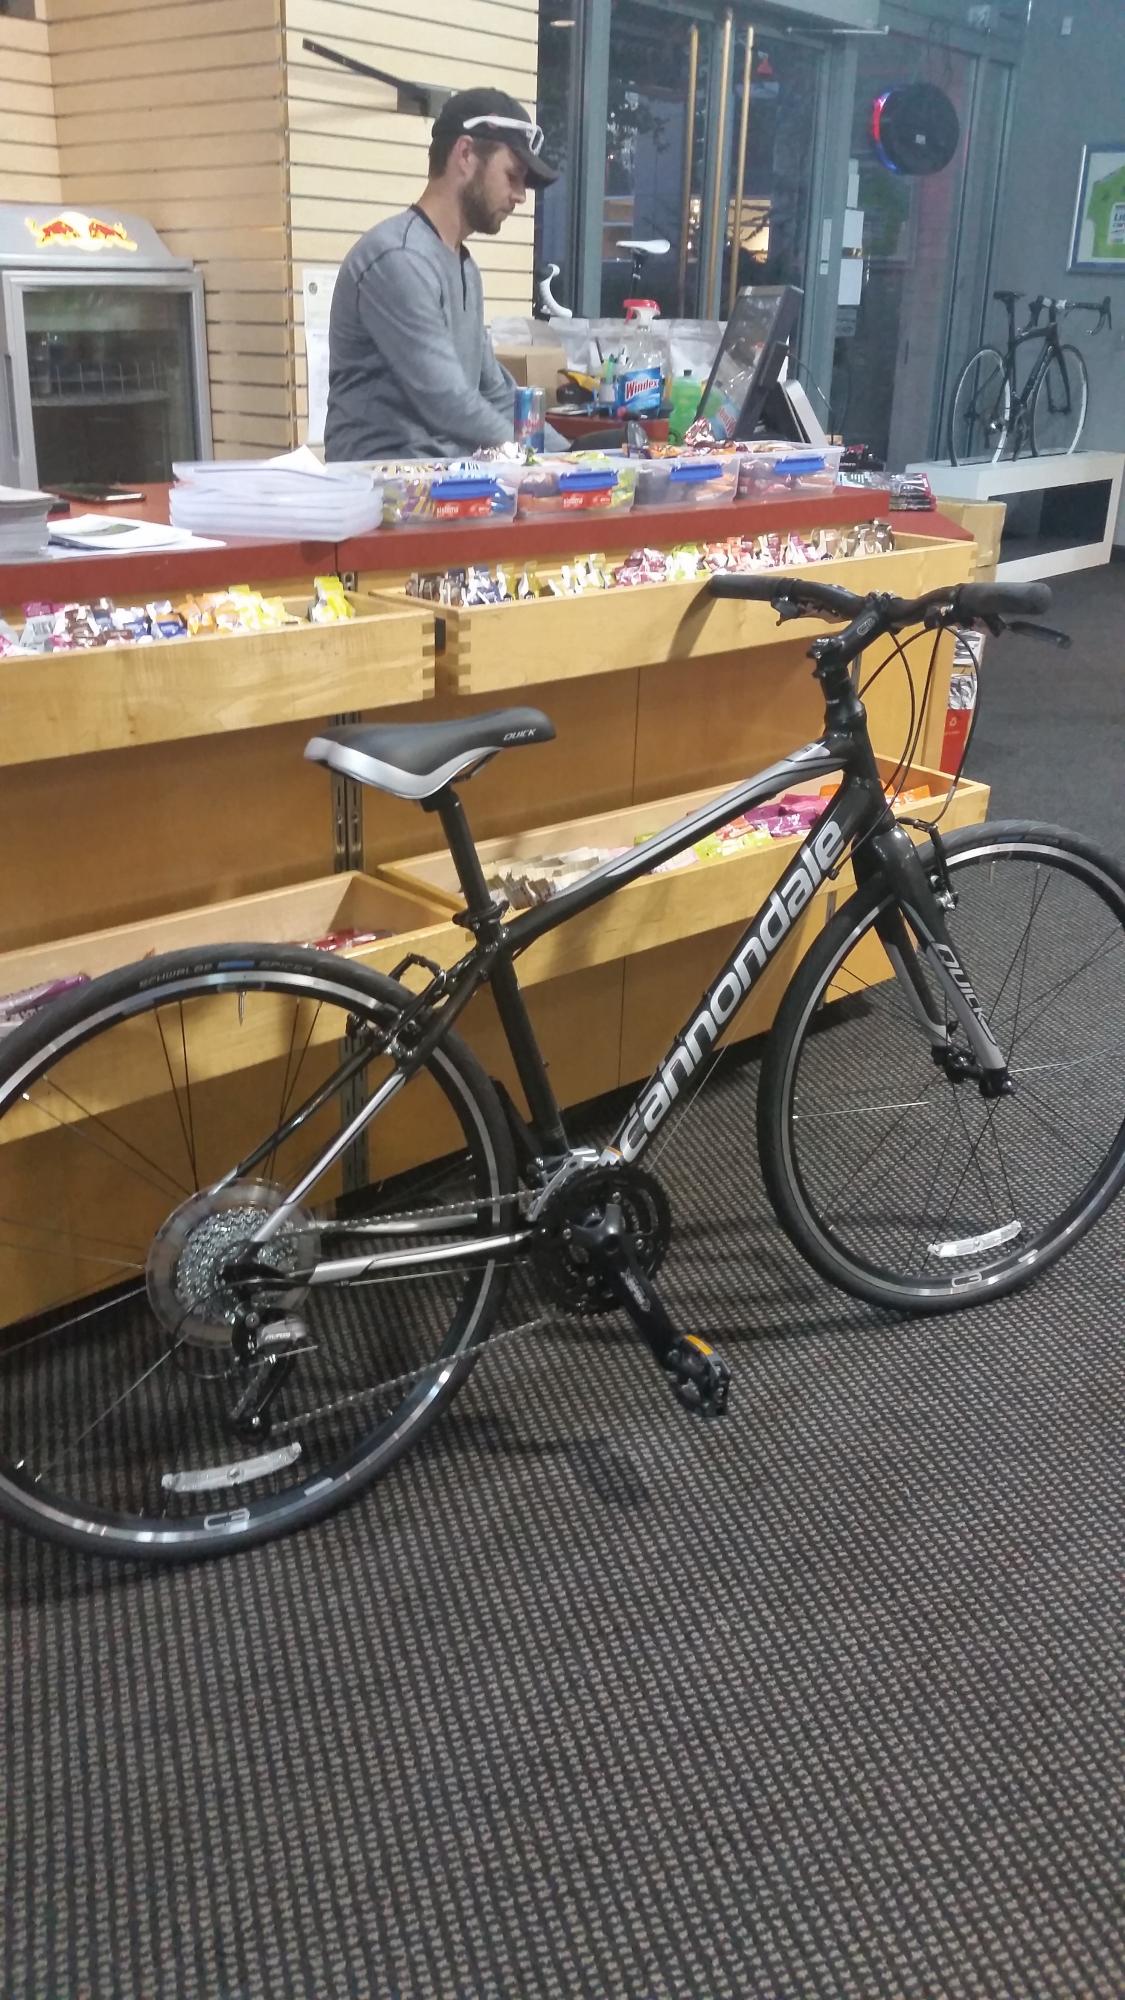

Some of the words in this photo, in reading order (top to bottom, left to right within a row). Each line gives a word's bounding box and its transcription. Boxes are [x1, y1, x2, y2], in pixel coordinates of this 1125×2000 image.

[625, 377, 660, 400] Windex
[503, 728, 537, 741] QUICK
[619, 820, 845, 1163] cannondale
[933, 943, 994, 1036] QUICK
